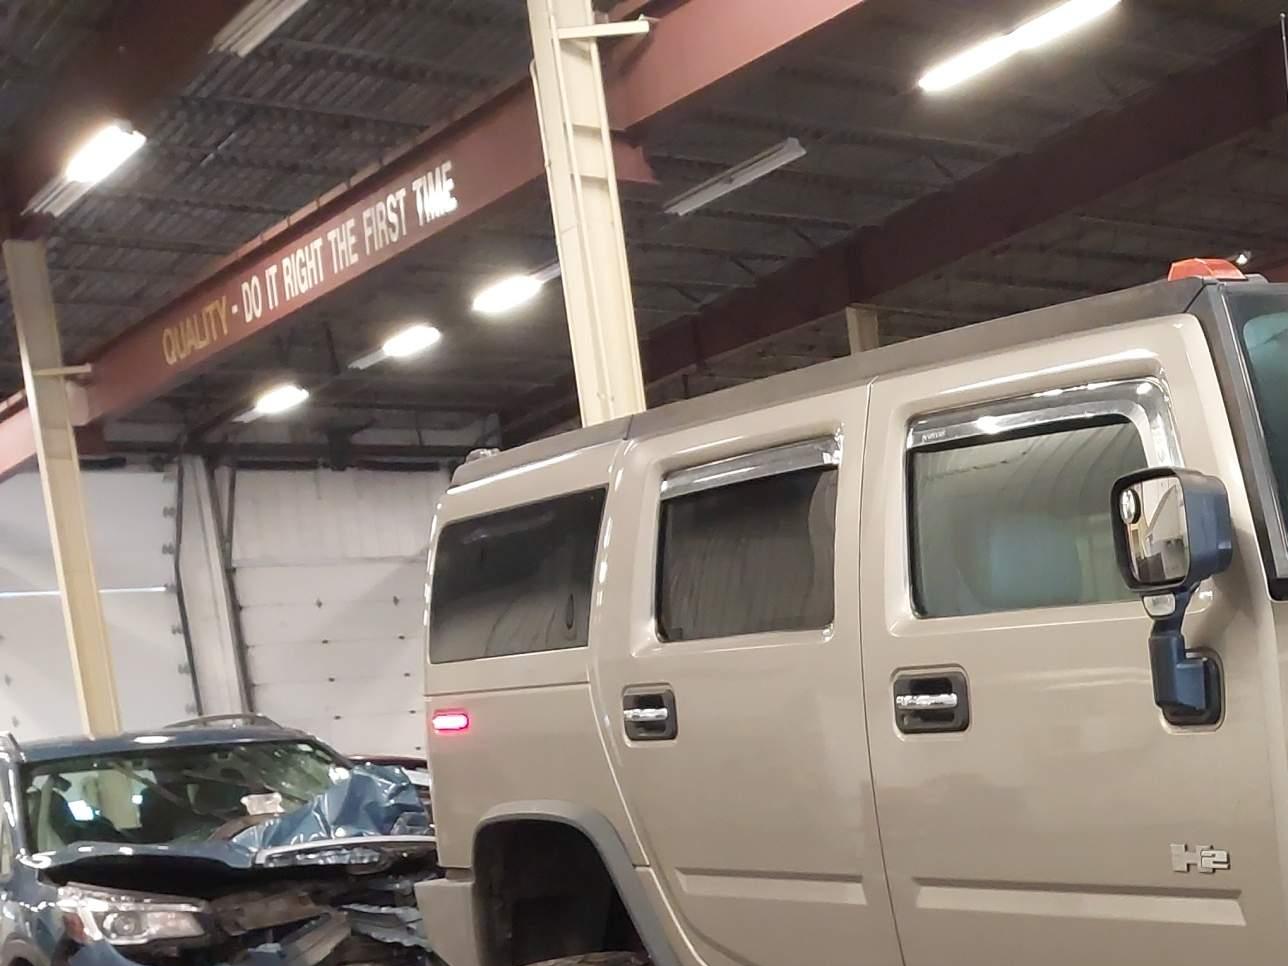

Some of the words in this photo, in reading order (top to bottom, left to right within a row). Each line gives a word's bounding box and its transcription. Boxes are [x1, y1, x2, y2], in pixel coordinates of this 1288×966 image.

[162, 295, 228, 365] QUALITY
[241, 275, 262, 323] DO
[265, 264, 279, 311] IT
[282, 237, 324, 301] RIGHT
[327, 218, 359, 274] THE
[362, 187, 407, 256] FIRST
[412, 160, 458, 227] TIME
[1170, 843, 1231, 874] H2
